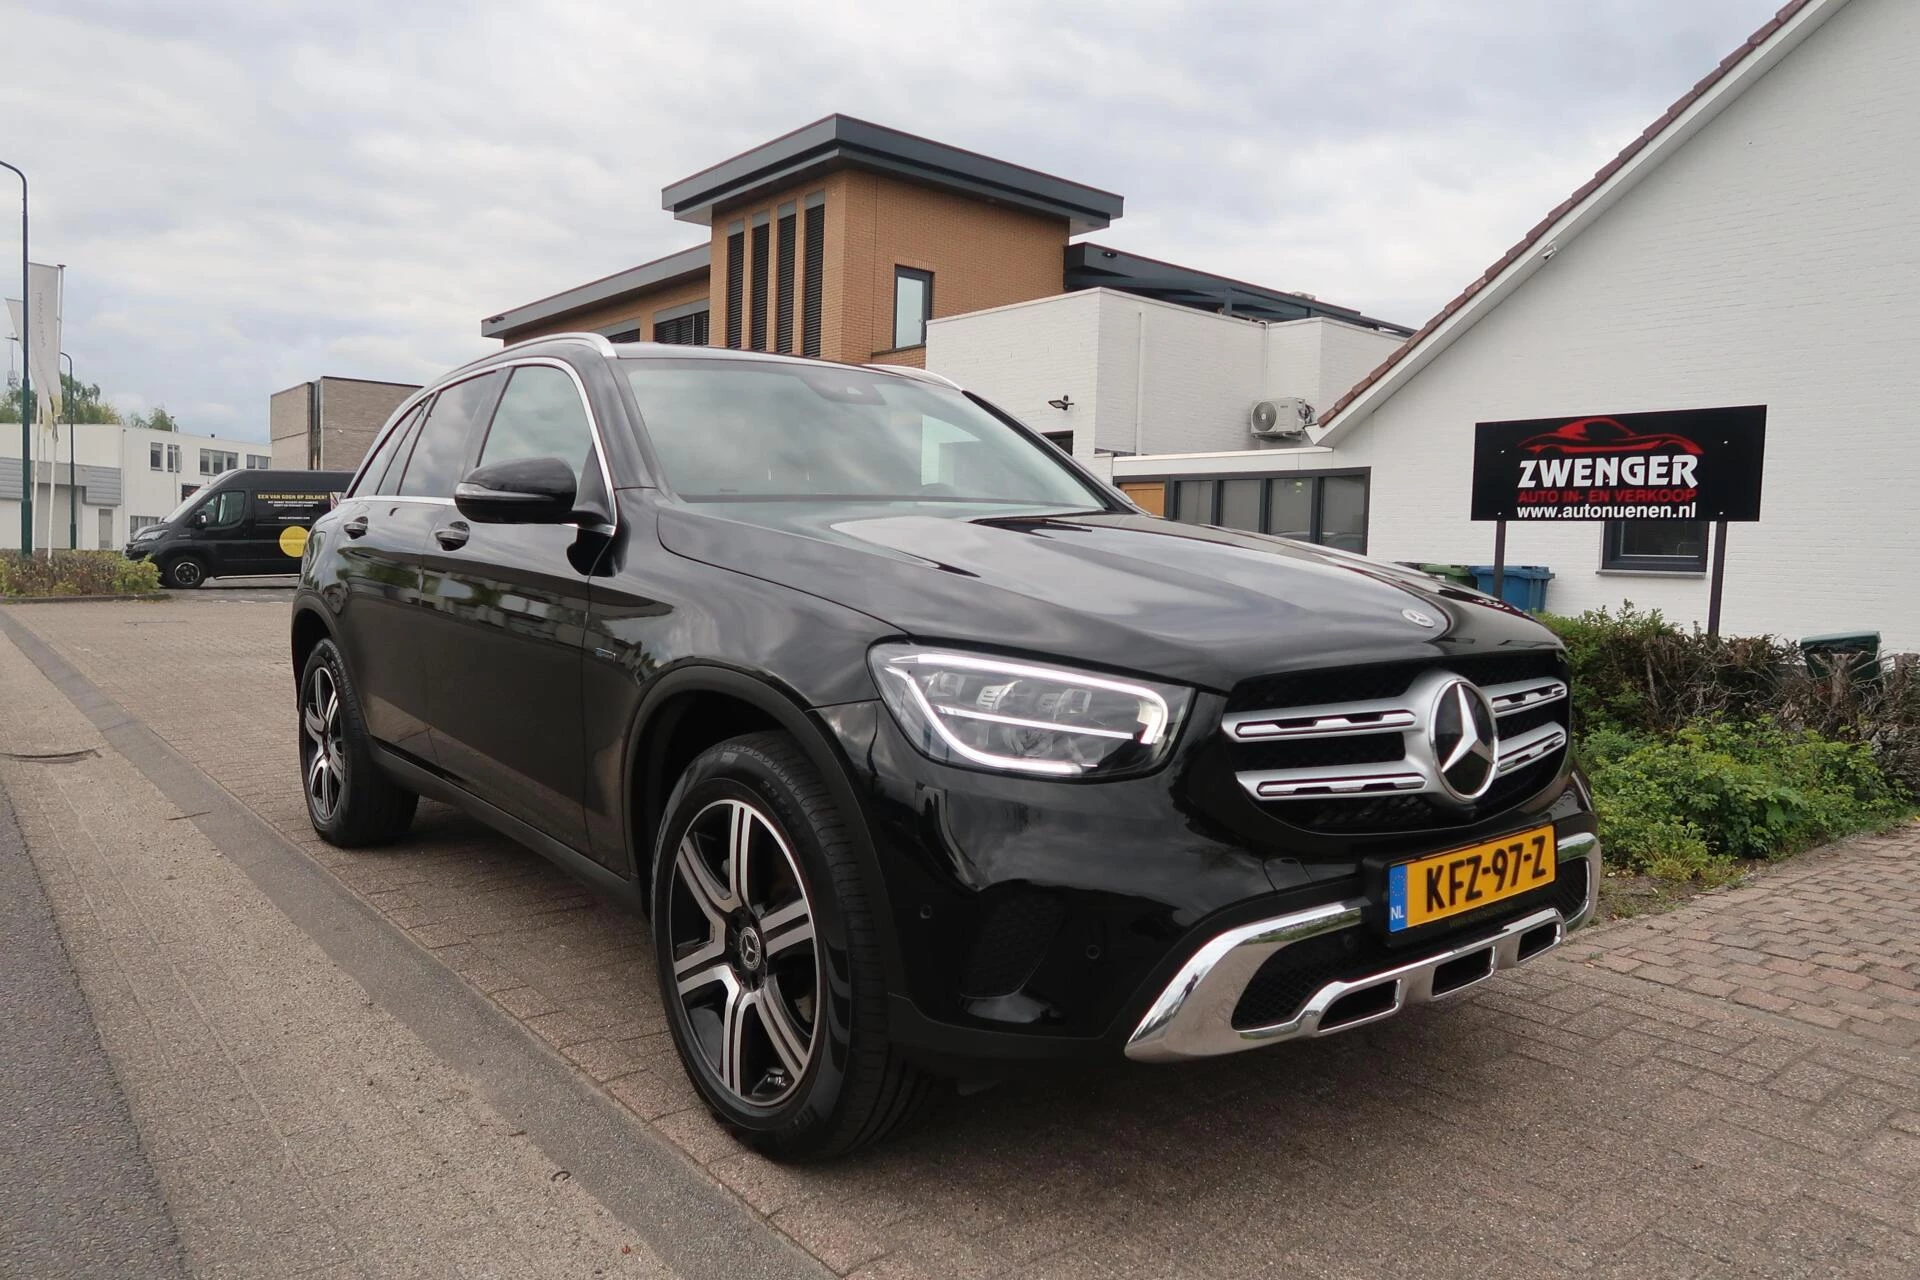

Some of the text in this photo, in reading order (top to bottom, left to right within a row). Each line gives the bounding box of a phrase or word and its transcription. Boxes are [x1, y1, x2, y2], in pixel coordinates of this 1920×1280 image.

[1517, 455, 1698, 488] ZWENGER
[1518, 489, 1697, 503] AUTO IN- EN VERKOOP
[1516, 502, 1697, 518] www.autonuenen.nl
[1426, 835, 1547, 913] KFZ-97-Z
[1390, 906, 1404, 920] NL
